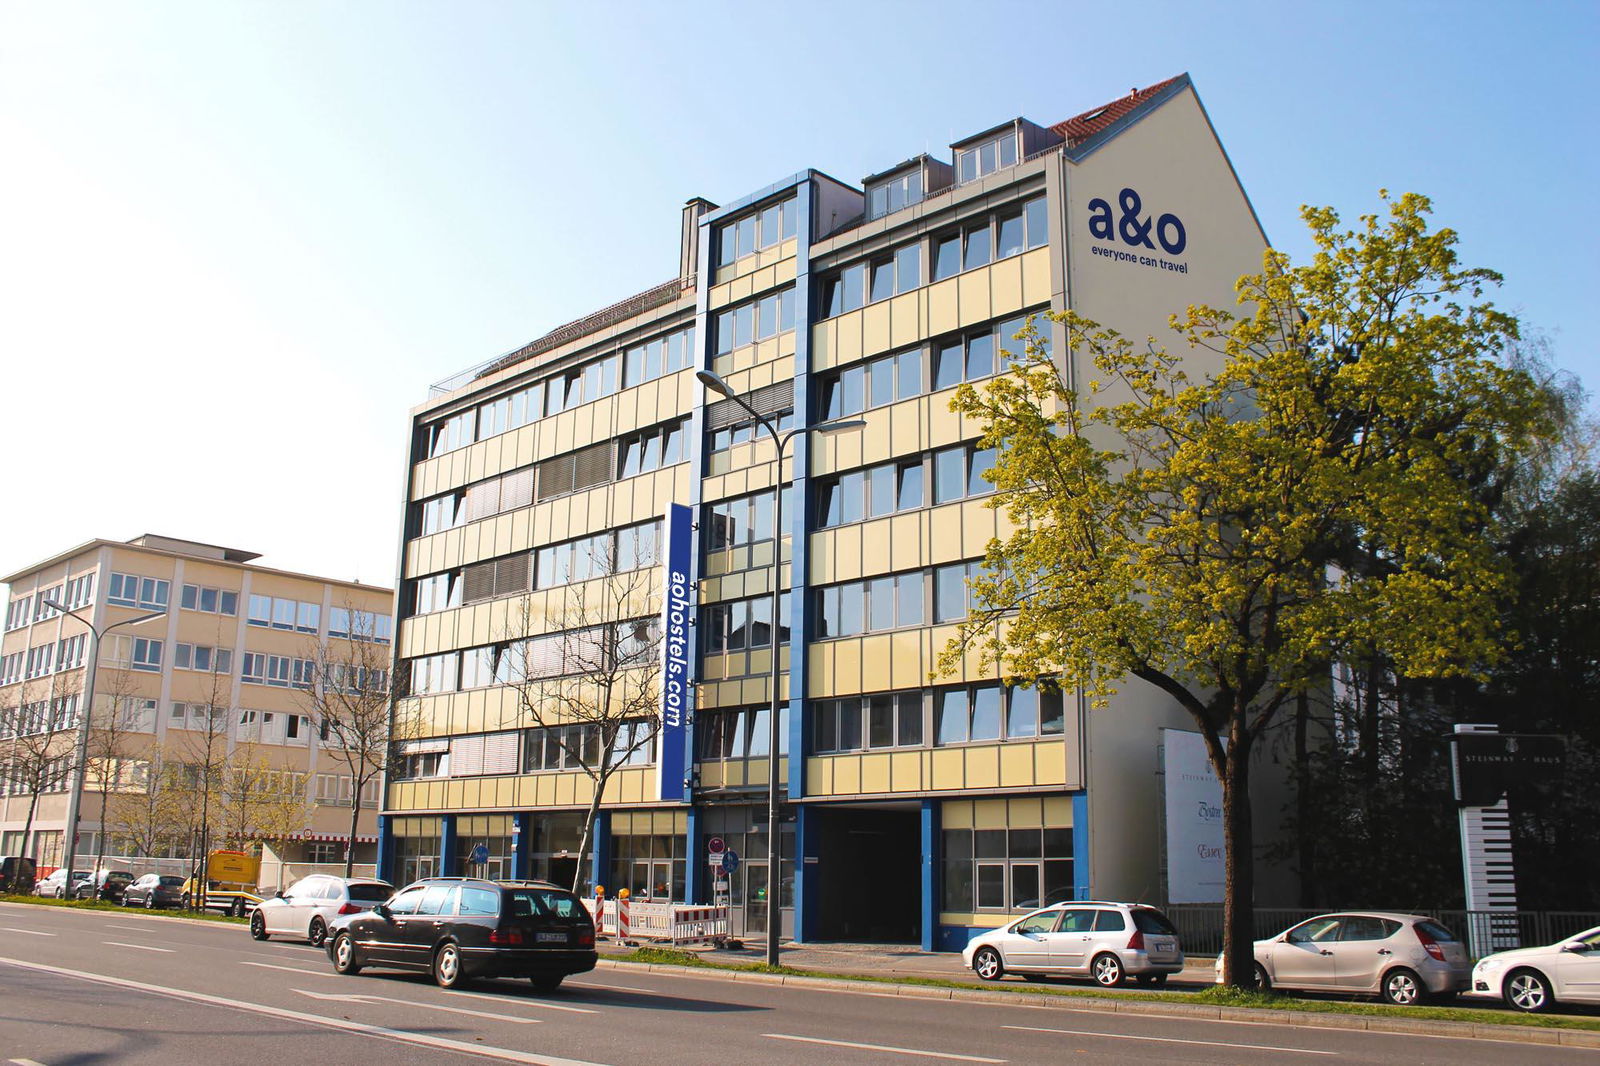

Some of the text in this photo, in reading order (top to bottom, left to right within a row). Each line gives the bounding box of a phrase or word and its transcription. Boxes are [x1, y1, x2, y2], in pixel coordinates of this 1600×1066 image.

[1087, 187, 1187, 256] a&o
[1091, 245, 1188, 275] everyone can travel
[666, 571, 690, 728] aohostels.com
